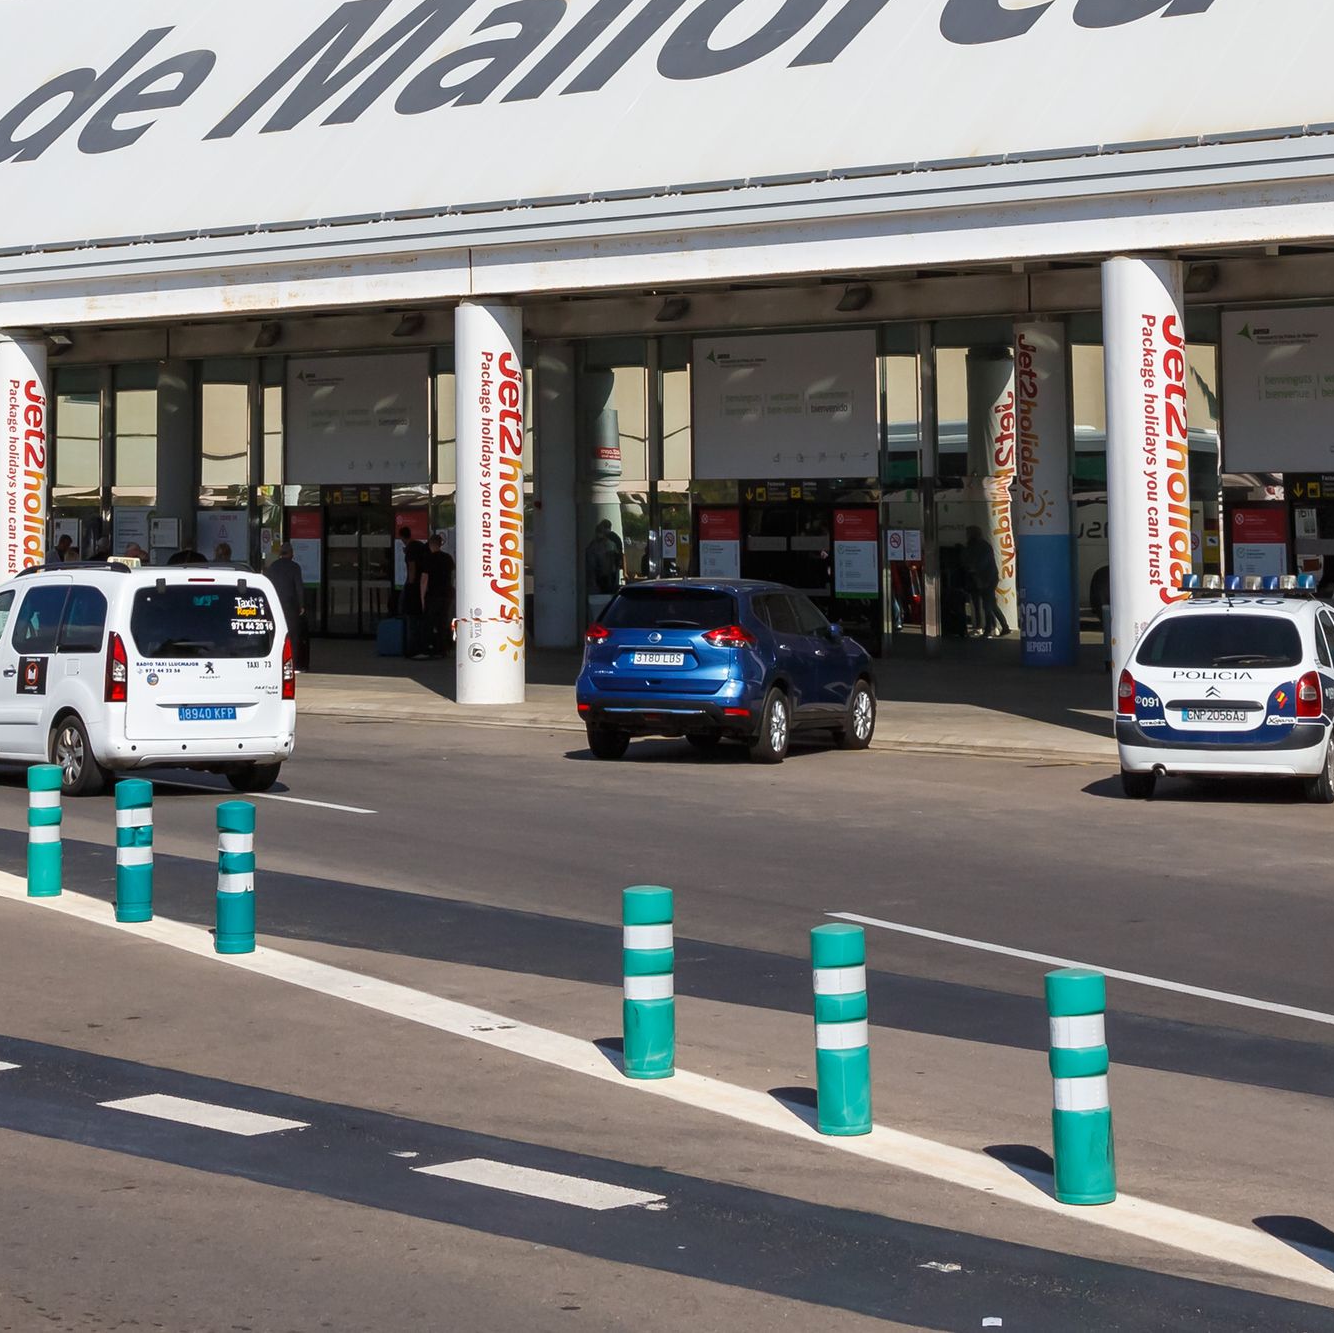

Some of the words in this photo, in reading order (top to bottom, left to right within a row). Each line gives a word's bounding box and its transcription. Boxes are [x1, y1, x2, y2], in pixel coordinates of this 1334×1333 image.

[1140, 314, 1156, 388] Package
[481, 351, 493, 413] Package
[6, 379, 20, 432] Package
[810, 404, 848, 413] bienvenido
[1017, 333, 1040, 504] Jet2holidays
[1142, 393, 1158, 465] holidays
[6, 436, 20, 488] holidays
[481, 418, 494, 477] holidays
[1159, 315, 1192, 604] Jet2holiday
[23, 380, 47, 573] Jet2holida
[481, 481, 492, 504] you
[490, 352, 524, 624] Jet2holidays
[1143, 470, 1158, 502] you
[6, 491, 17, 514] you
[8, 518, 17, 540] can
[482, 507, 492, 538] can
[1147, 506, 1159, 538] can
[8, 543, 19, 574] trust
[482, 542, 494, 578] trust
[1148, 542, 1163, 585] trust
[231, 622, 244, 630] 971
[245, 622, 255, 630] 44
[247, 661, 260, 669] TAXI
[636, 652, 660, 663] 3180
[184, 708, 211, 720] 8940
[214, 707, 234, 719] KFP
[1141, 697, 1160, 707] 091
